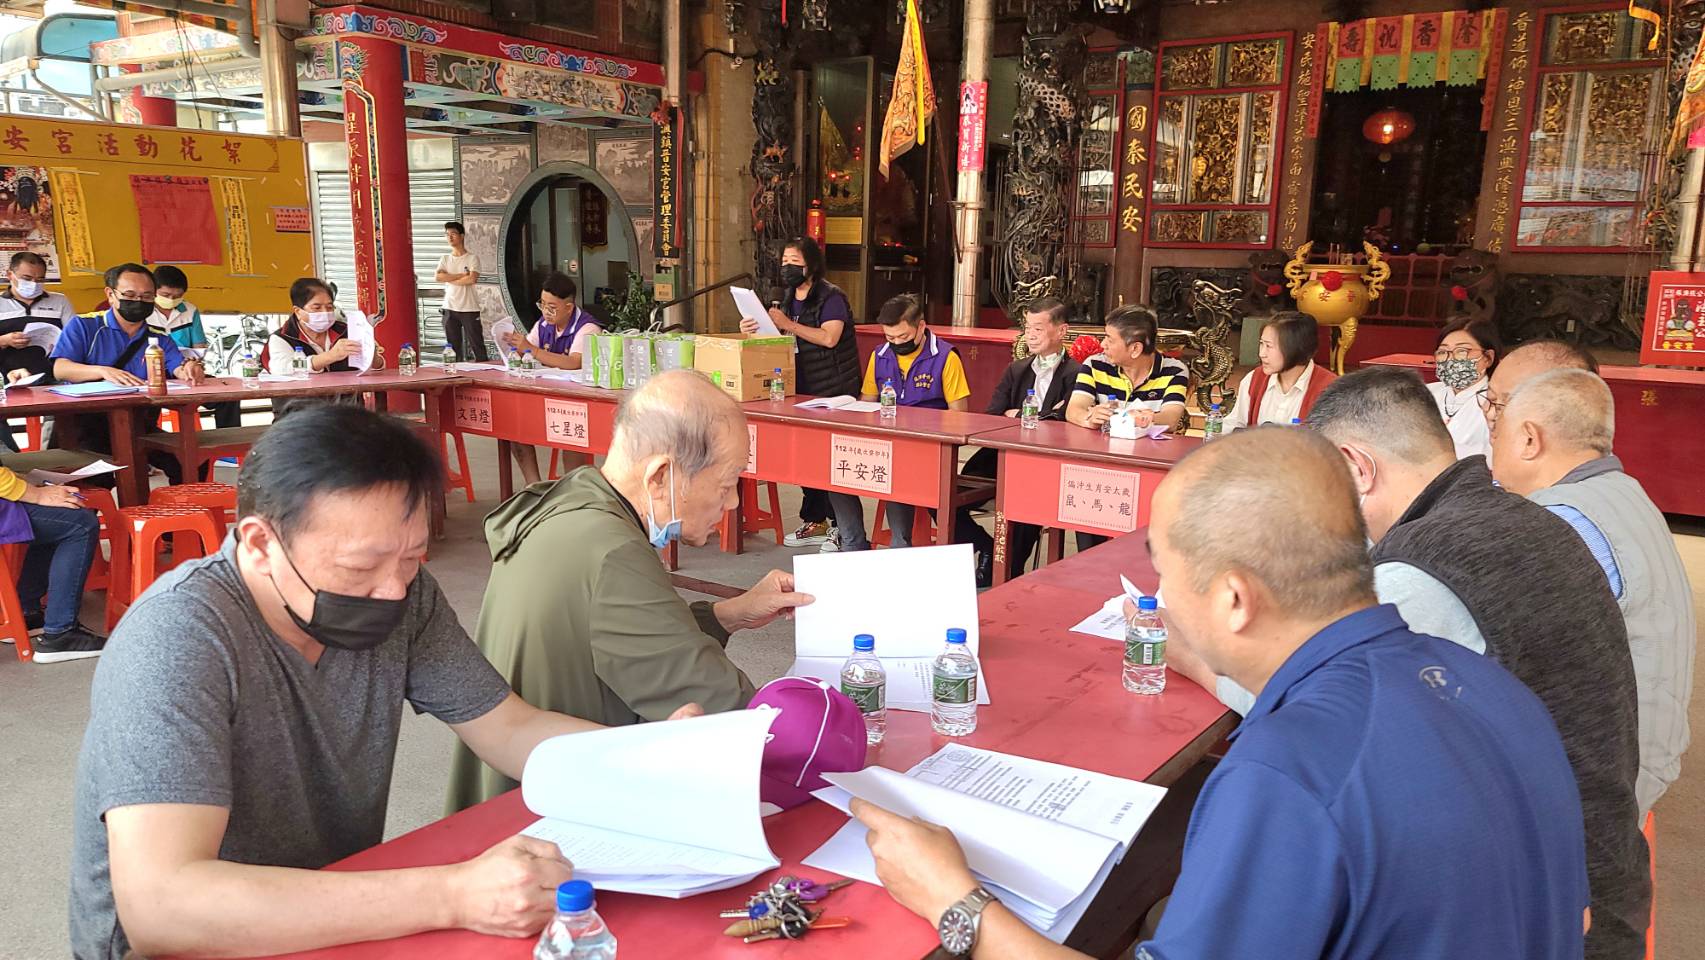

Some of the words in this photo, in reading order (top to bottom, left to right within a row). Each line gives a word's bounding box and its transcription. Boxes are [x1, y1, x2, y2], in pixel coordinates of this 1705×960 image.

[3, 125, 242, 165] 安宮活動花絮
[1121, 105, 1148, 232] 國泰民安
[458, 407, 490, 424] 文昌燈
[550, 421, 585, 439] 七星燈
[837, 460, 888, 484] 平安燈
[1067, 480, 1131, 498] 偏沖生肖安太歲
[1066, 494, 1132, 517] 鼠、馬、龍
